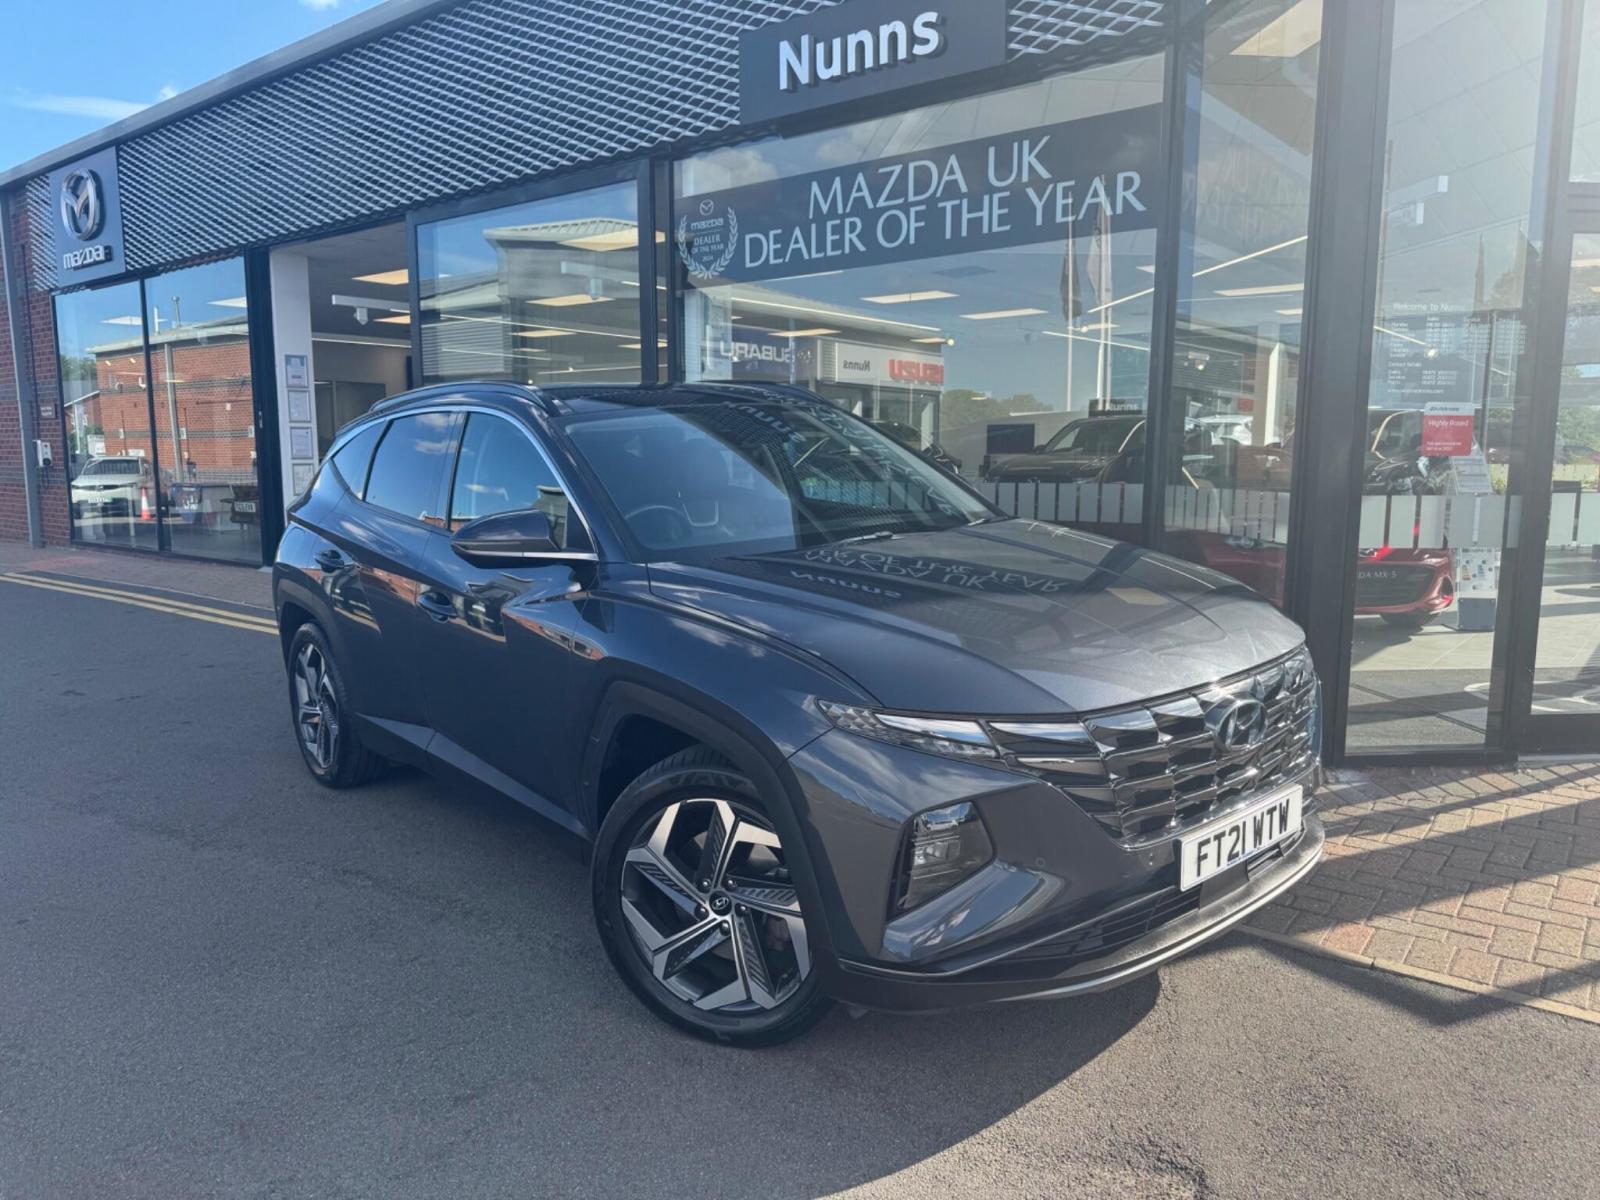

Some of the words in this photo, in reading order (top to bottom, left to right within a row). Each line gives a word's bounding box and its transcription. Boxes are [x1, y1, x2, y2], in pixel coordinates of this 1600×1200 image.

[779, 11, 940, 90] Nunns
[809, 154, 968, 219] MAZDA
[987, 136, 1051, 185] UK
[64, 244, 106, 270] mazda
[695, 234, 721, 246] DEALER
[745, 216, 866, 268] DEALER
[876, 208, 926, 250] OF
[938, 192, 1011, 240] THE
[1026, 171, 1146, 226] YEAR
[1197, 820, 1247, 877] FT21
[1253, 798, 1290, 848] WTW
